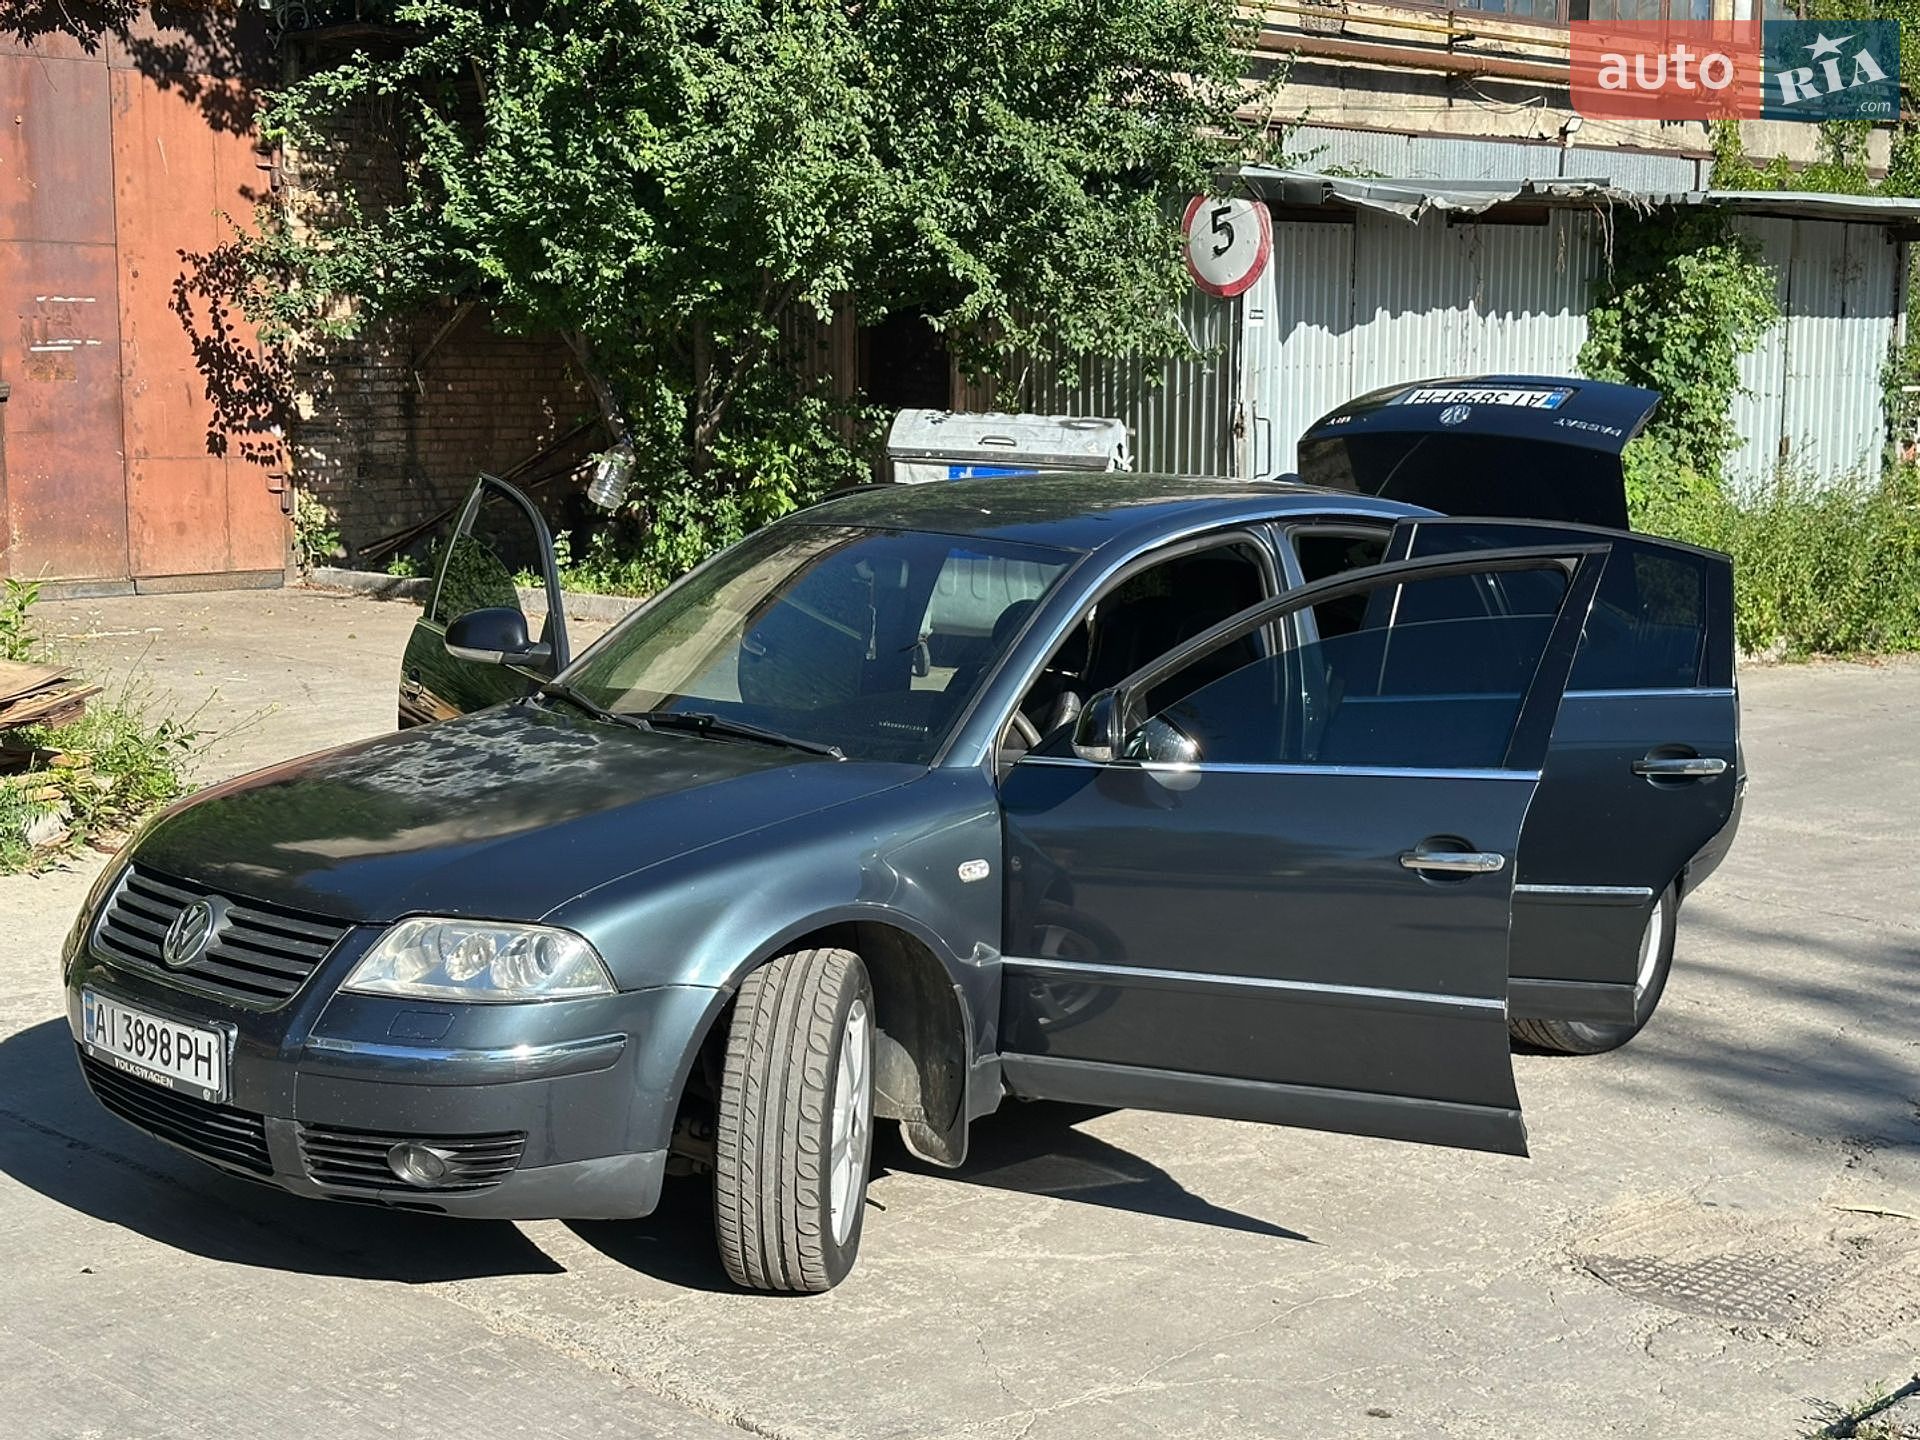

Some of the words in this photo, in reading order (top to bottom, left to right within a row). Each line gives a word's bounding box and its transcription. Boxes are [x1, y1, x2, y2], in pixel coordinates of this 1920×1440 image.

[1211, 206, 1235, 256] 5
[95, 1003, 116, 1047] AI
[122, 1014, 172, 1067] 3898
[176, 1031, 212, 1081] PH
[113, 1057, 174, 1088] VOLKSWAGEN
